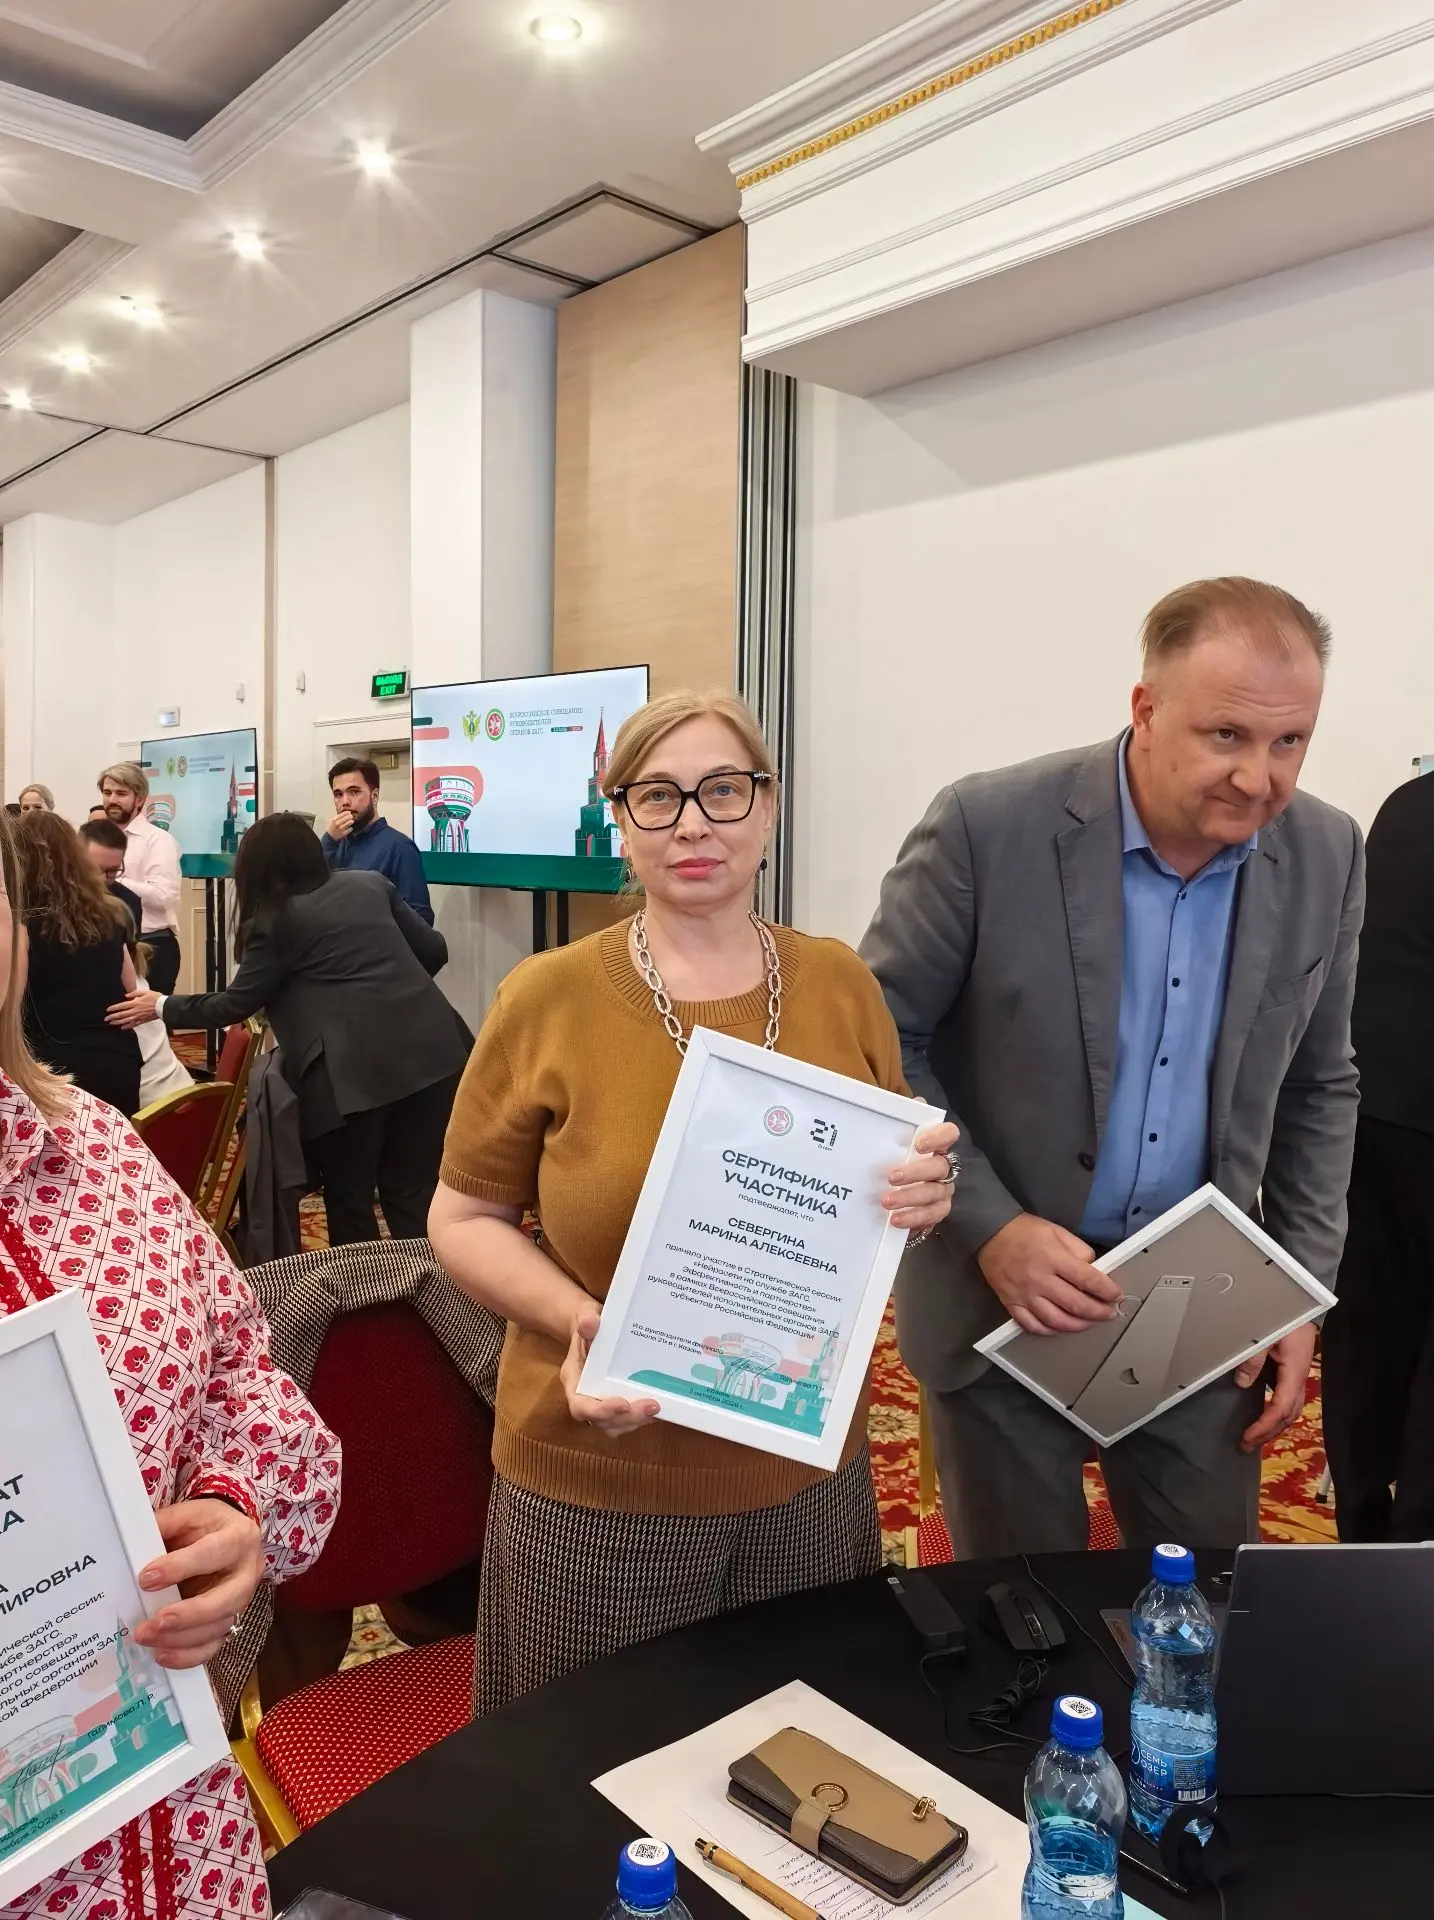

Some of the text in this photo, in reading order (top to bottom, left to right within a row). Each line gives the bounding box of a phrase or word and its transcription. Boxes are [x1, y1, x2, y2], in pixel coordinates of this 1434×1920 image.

[380, 685, 396, 695] EXIT
[722, 1149, 852, 1200] СЕРТИФИКАТ
[724, 1169, 838, 1218] УЧАСТНИКА
[738, 1193, 815, 1223] подтверждает, что
[688, 1218, 838, 1274] МАРИНА АЛЕКСЕЕВНА
[727, 1217, 805, 1249] СЕВЕРГИНА
[665, 1243, 702, 1259] приняла
[702, 1255, 737, 1270] участие
[744, 1267, 811, 1293] Стратегической
[811, 1289, 844, 1304] сессии:
[682, 1265, 752, 1293] Эффективность
[743, 1277, 754, 1285] на
[755, 1280, 788, 1296] службе
[788, 1290, 811, 1303] ЗАГС.
[647, 1275, 840, 1339] руководителей исполнительных органов ЗАГС
[670, 1291, 815, 1340] субъектов Российской Федерации
[676, 1274, 708, 1289] рамках
[708, 1283, 777, 1310] Всероссийского
[777, 1306, 825, 1325] совещания
[0, 1510, 26, 1535] А
[55, 1591, 105, 1624] сессии:
[25, 1629, 63, 1654] ЗАГС.
[0, 1633, 100, 1697] ого совещания
[41, 1649, 95, 1684] органов
[0, 1659, 98, 1722] ой Федерации
[87, 1705, 136, 1739] Галимова
[1141, 1750, 1167, 1768] СЕМЬ
[1141, 1760, 1167, 1776] ОЗЕР
